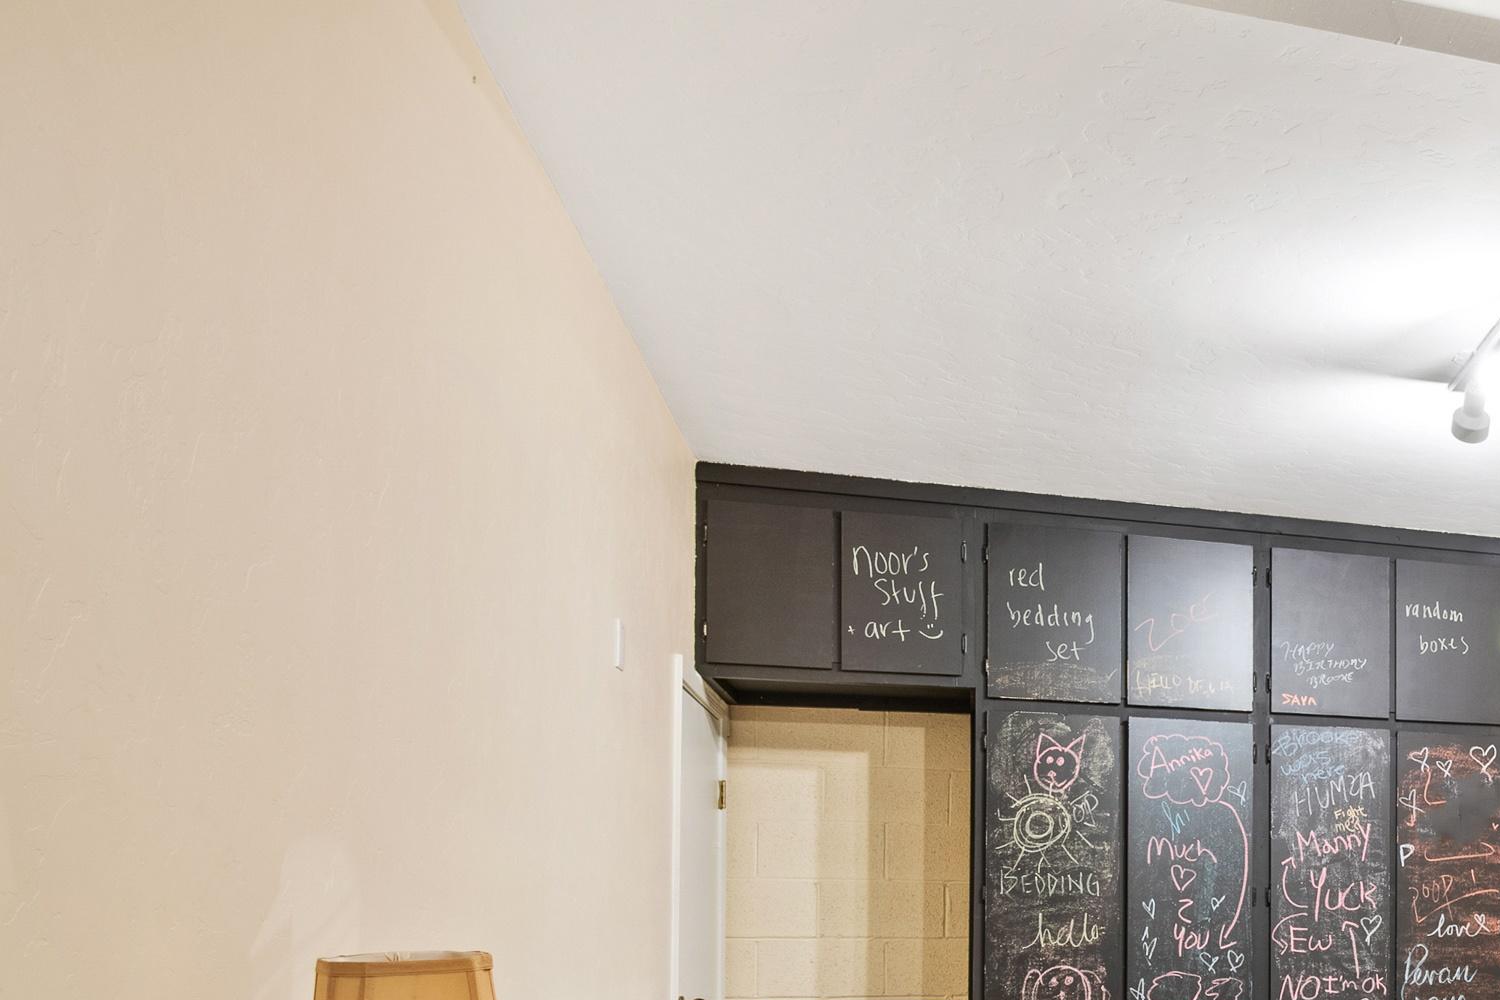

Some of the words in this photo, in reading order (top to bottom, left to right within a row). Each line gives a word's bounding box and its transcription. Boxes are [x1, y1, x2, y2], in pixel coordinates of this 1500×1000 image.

[1009, 562, 1045, 591] red
[1405, 600, 1463, 623] random
[864, 619, 911, 642] art
[1419, 634, 1469, 655] boxes
[1045, 641, 1087, 662] set
[1150, 746, 1214, 777] Annika
[1296, 823, 1371, 862] Manny
[1000, 866, 1100, 897] BEDDING
[1022, 912, 1100, 950] hello
